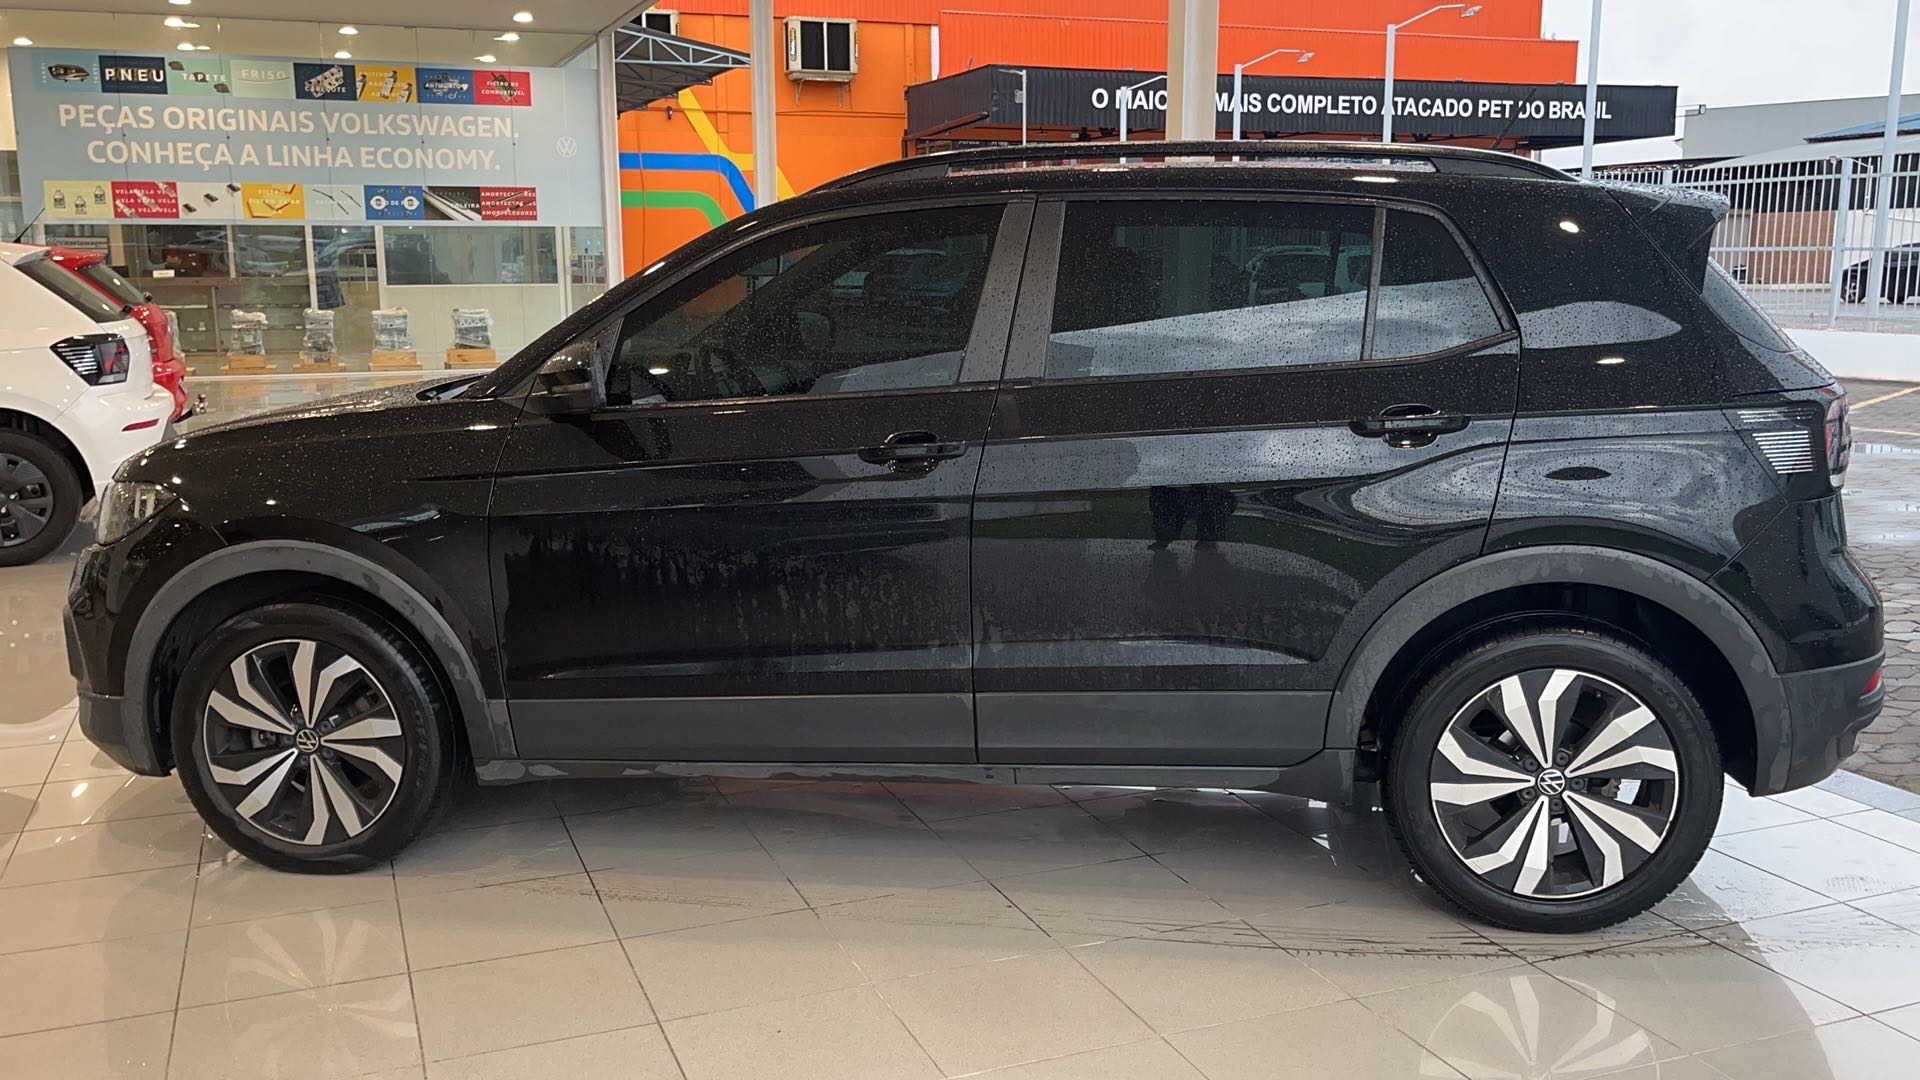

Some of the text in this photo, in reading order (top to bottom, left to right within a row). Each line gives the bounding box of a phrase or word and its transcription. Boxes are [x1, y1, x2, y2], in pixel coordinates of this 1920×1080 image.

[105, 67, 164, 82] PNEU
[182, 72, 227, 82] TAPETE
[241, 69, 286, 80] FRISO
[1091, 88, 1109, 109] O
[1115, 89, 1168, 111] MAIO
[1266, 93, 1377, 115] COMPLETO
[1478, 99, 1514, 119] PET
[1518, 100, 1545, 119] DO
[1548, 101, 1612, 119] BRAIL
[59, 103, 519, 139] PEÇAS ORIGINAIS VOLKSWAGEN.
[88, 140, 500, 171] CONHEÇA A LINHA ECONOMY.
